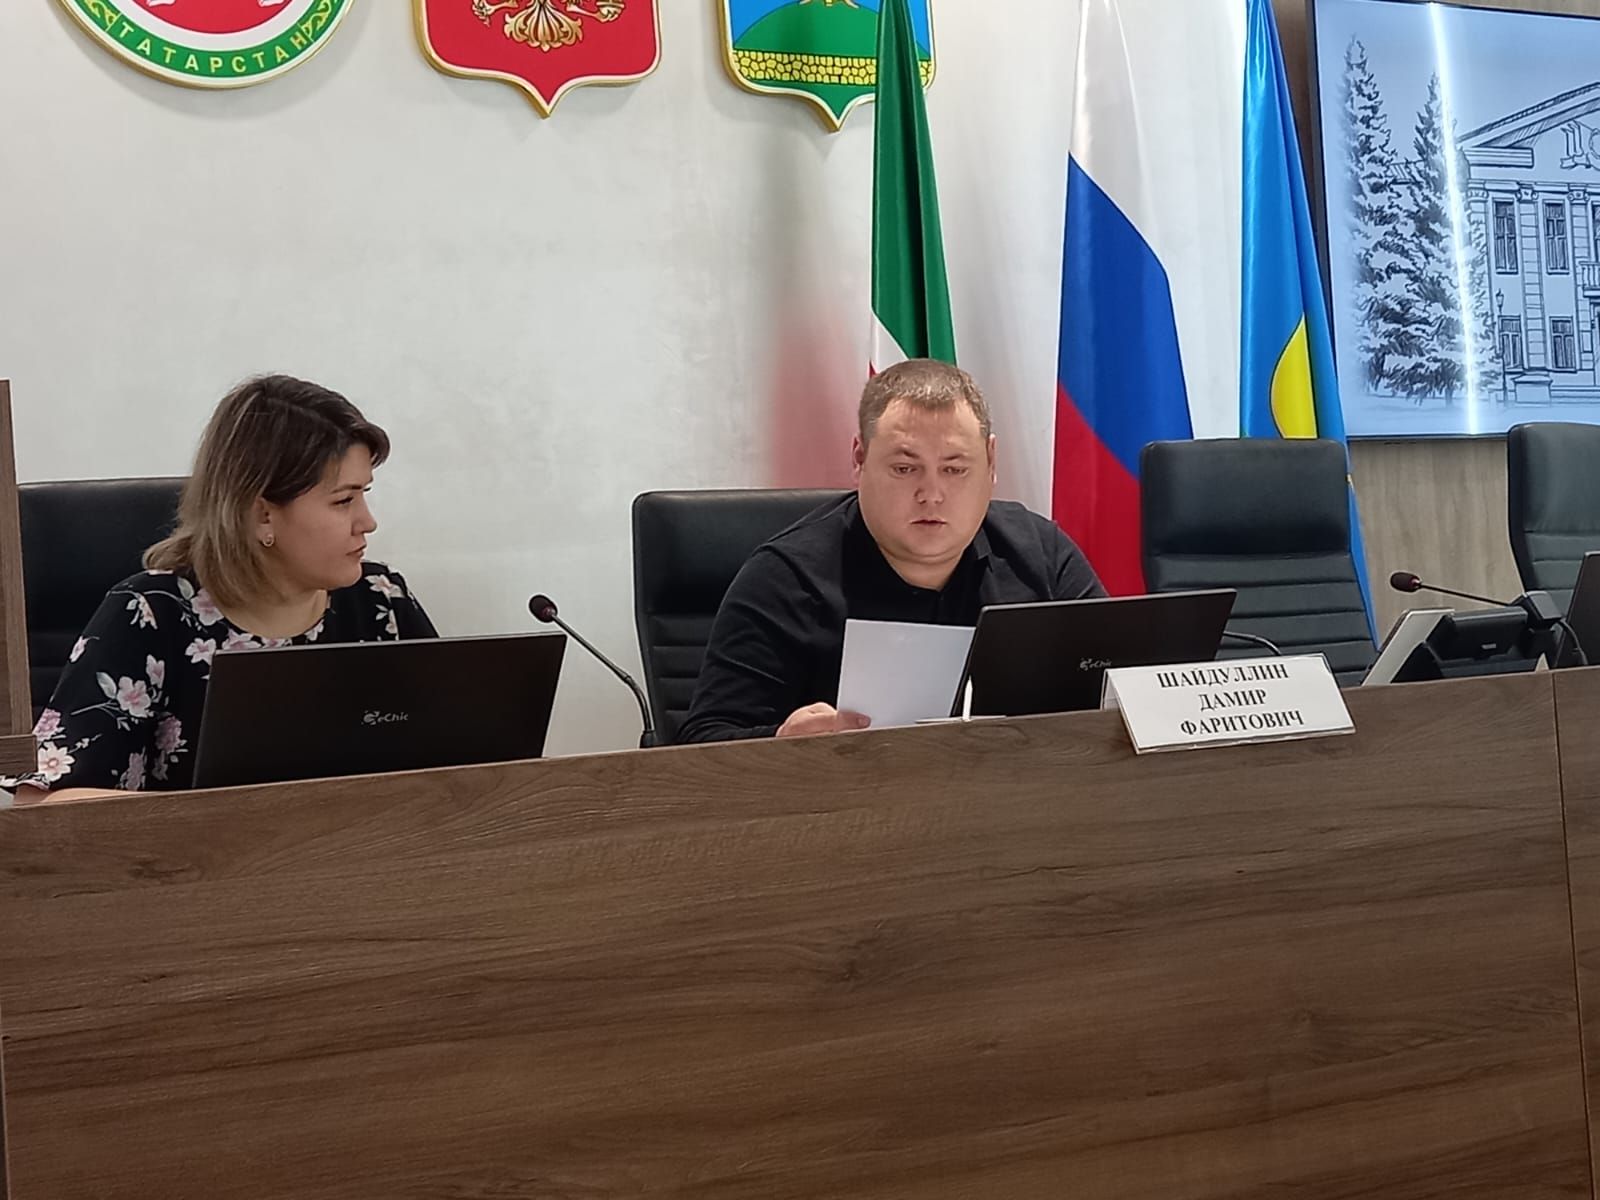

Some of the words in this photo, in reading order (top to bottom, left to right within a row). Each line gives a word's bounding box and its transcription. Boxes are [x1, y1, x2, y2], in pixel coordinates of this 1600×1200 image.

[119, 22, 307, 73] ТАТАРСТАН
[1156, 664, 1289, 688] ШАЙДУЛЛИН
[1198, 689, 1267, 711] ДАМИР
[1180, 710, 1305, 735] ФАРИТОВИЧ
